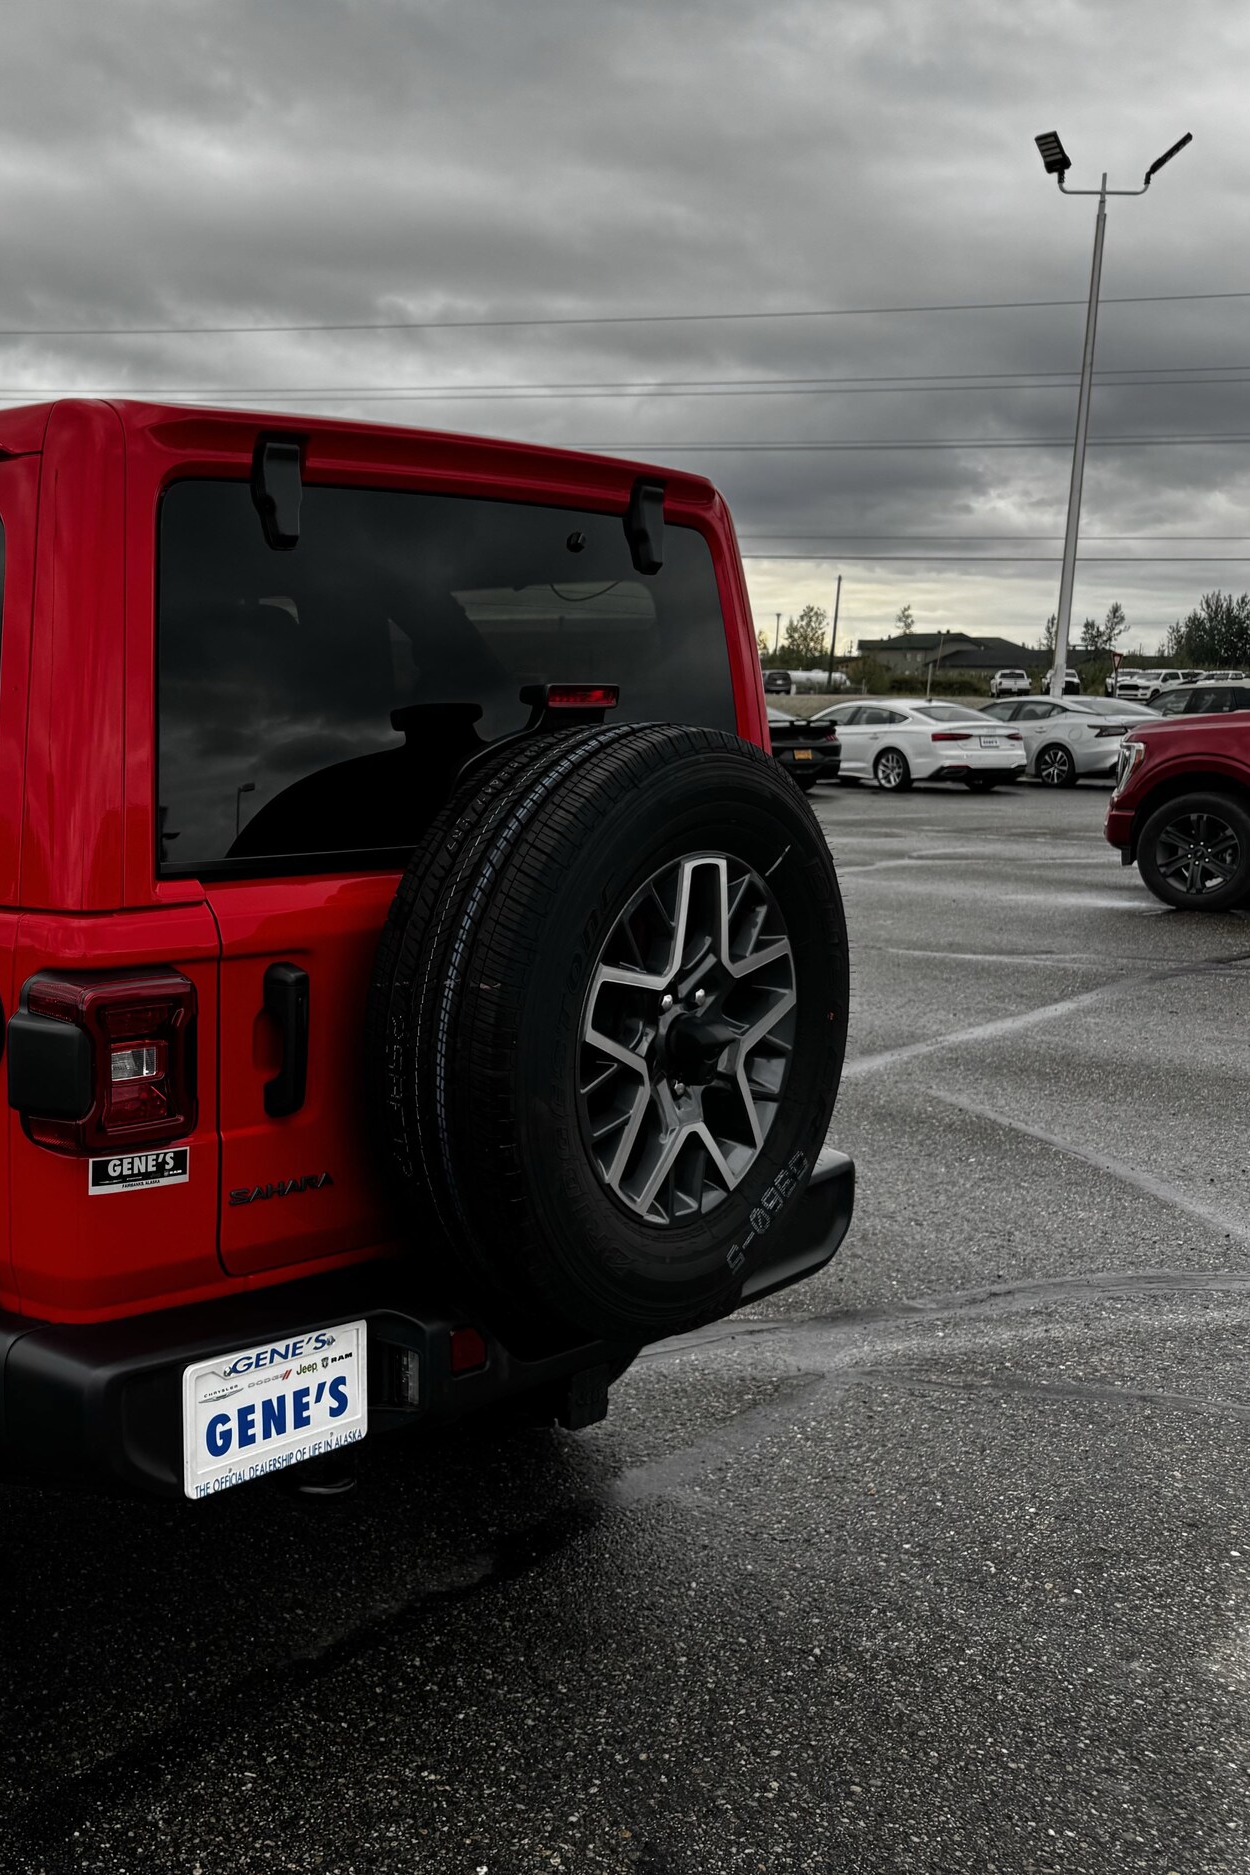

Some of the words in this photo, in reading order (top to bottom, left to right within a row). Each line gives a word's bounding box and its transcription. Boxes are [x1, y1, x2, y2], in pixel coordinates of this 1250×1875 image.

[107, 1152, 175, 1177] GENE'S
[229, 1172, 334, 1206] SAHARA
[203, 1384, 240, 1399] CHRYSLER
[247, 1372, 286, 1388] DODGE
[296, 1361, 318, 1376] Jeep
[330, 1351, 353, 1364] RAM
[230, 1332, 329, 1375] GENE'S
[205, 1375, 349, 1458] GENE'S
[194, 1482, 211, 1498] THE
[212, 1471, 247, 1493] OFFICIAL
[249, 1453, 294, 1479] DEALERSHIP
[295, 1447, 307, 1463] OF
[308, 1443, 323, 1458] LIFE
[323, 1438, 334, 1453] IN
[334, 1428, 364, 1447] ALASKA
